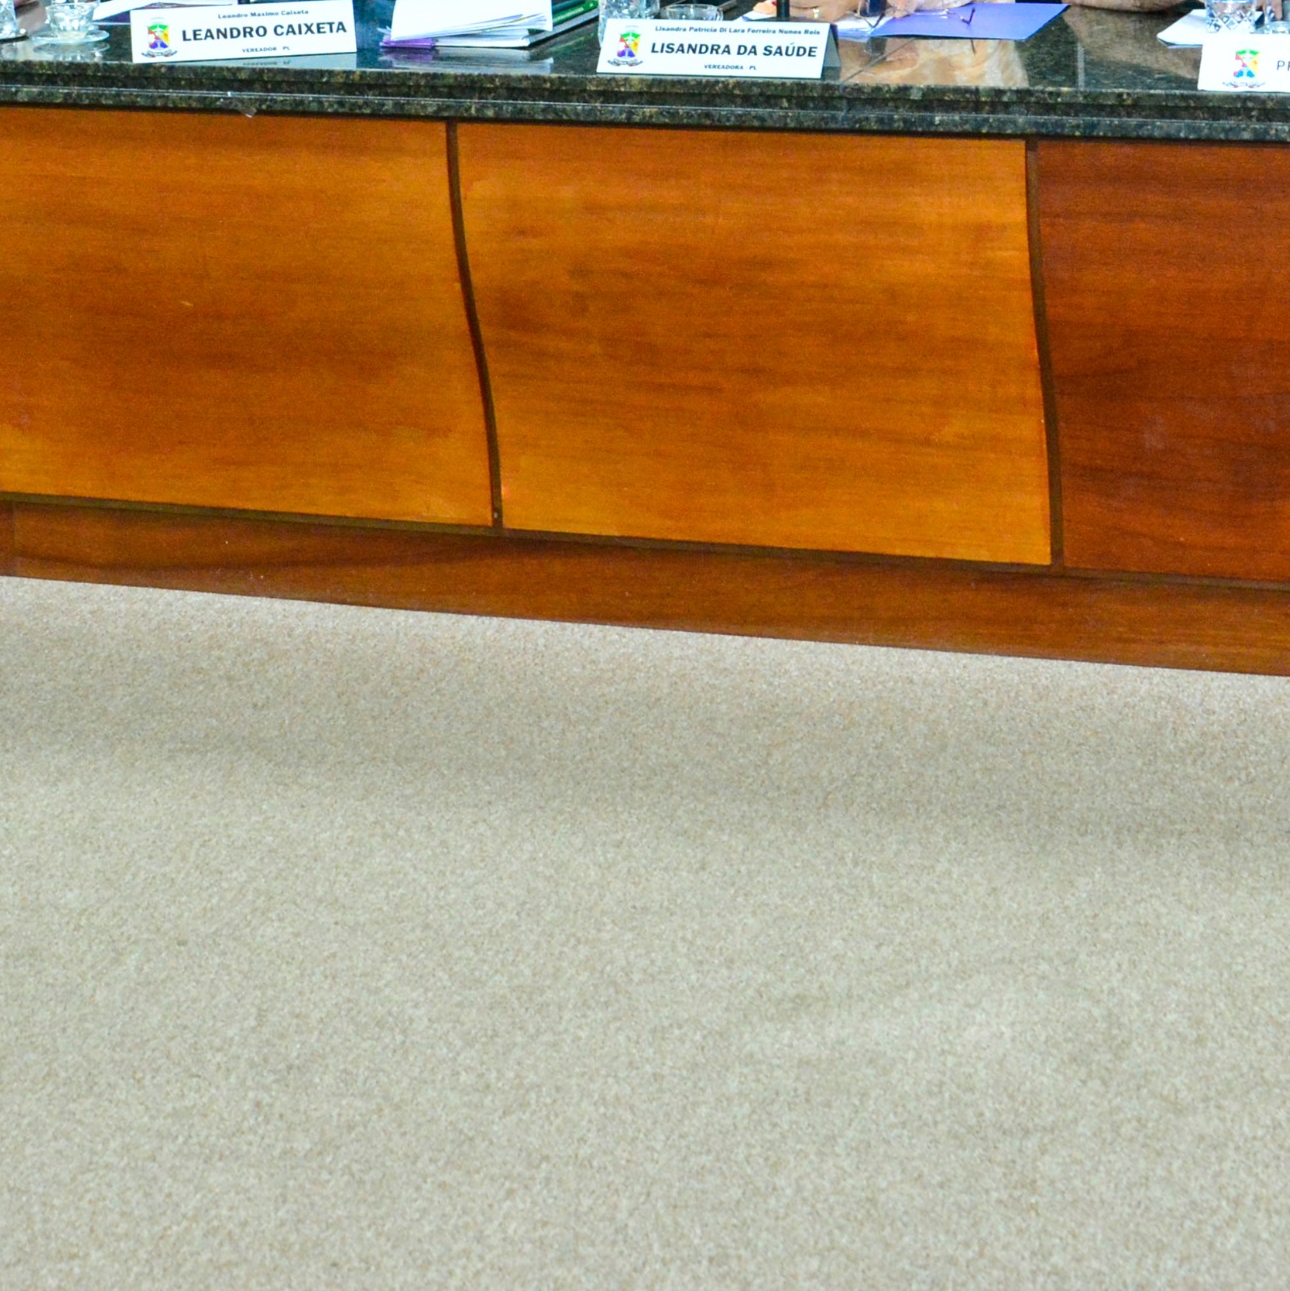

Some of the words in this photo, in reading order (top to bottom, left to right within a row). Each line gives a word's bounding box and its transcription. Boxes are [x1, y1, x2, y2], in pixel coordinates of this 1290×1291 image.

[182, 25, 268, 42] LEANDRO
[273, 21, 347, 37] CAIXETA
[651, 42, 731, 55] LISANDRA
[736, 44, 758, 56] DA
[762, 42, 818, 58] SAÚDE
